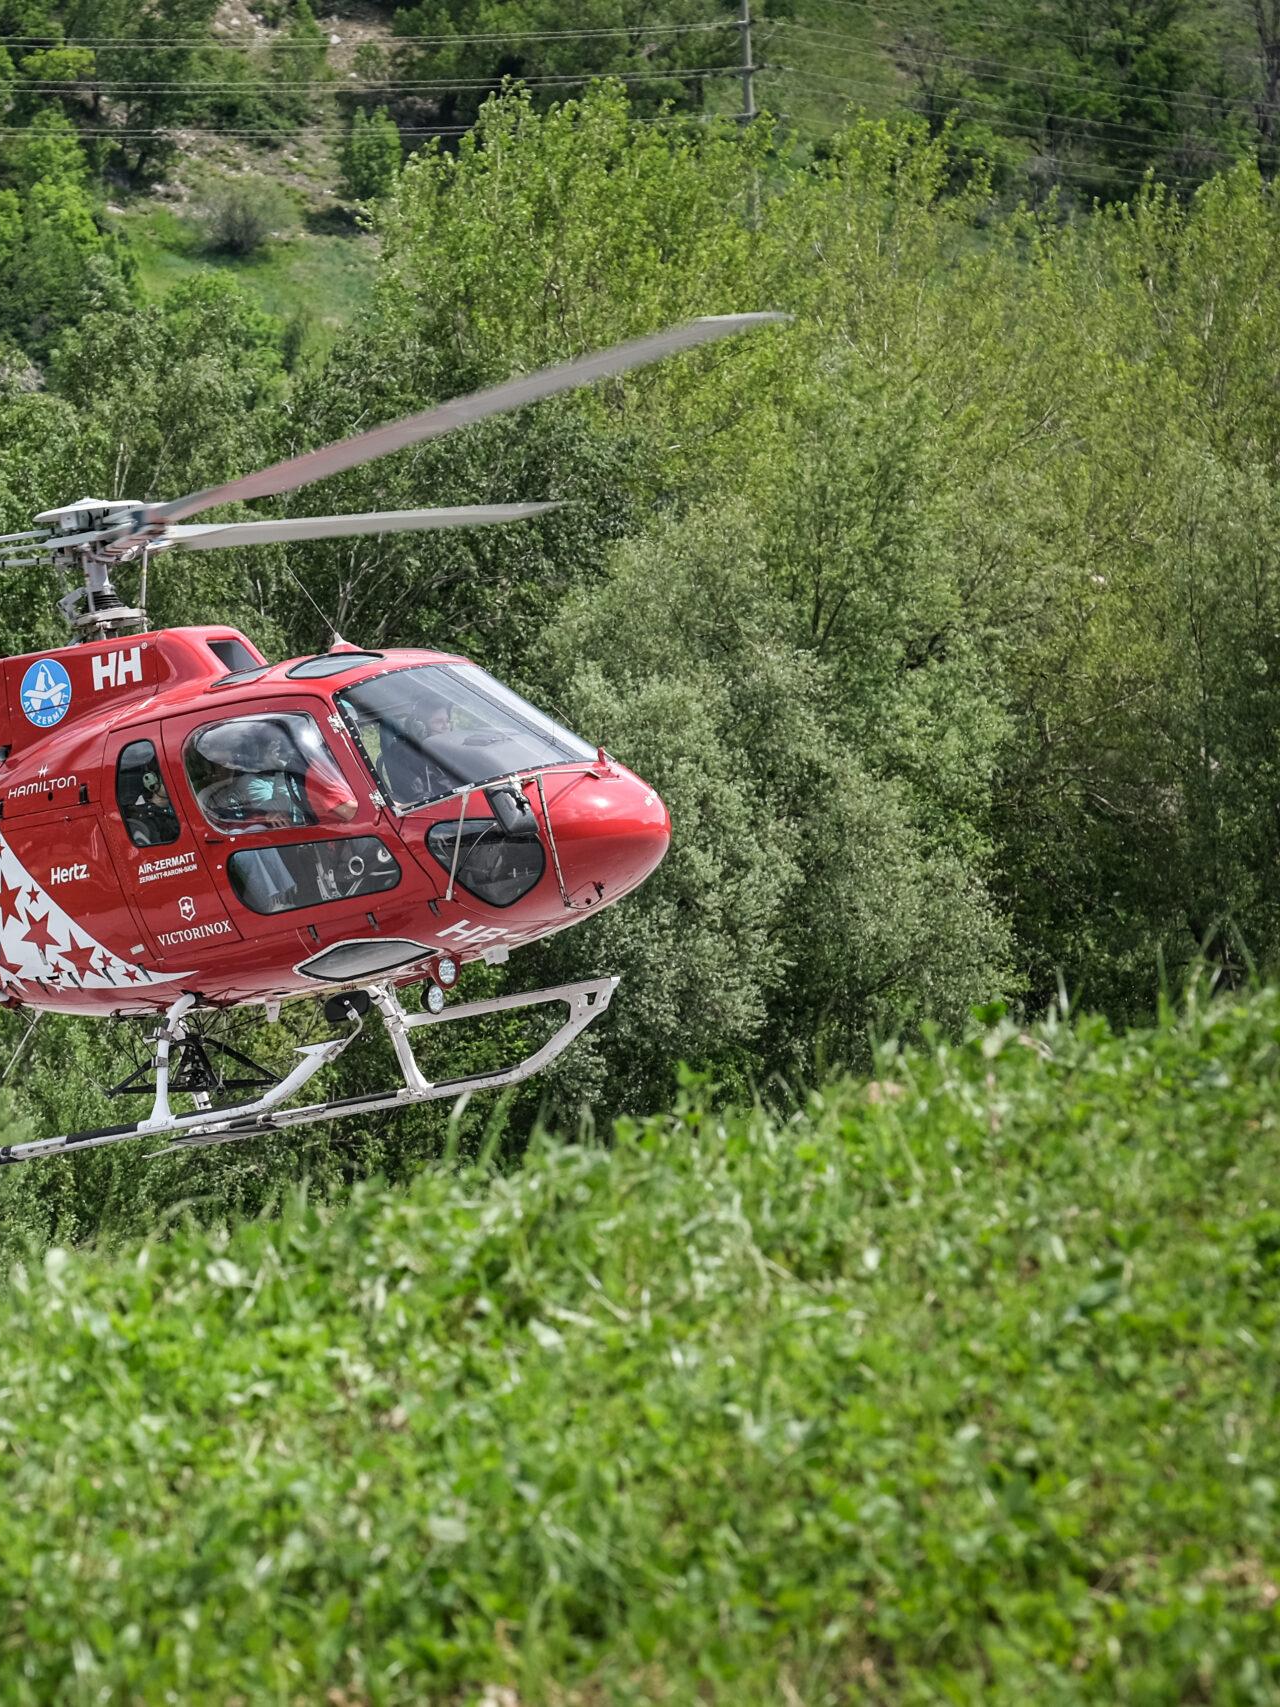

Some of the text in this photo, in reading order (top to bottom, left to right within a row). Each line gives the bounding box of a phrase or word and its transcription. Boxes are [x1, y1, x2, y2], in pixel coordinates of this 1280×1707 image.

[7, 775, 77, 799] HAMILTON
[50, 863, 88, 885] Hertz
[138, 851, 196, 876] AIR-ZERMATT
[157, 919, 232, 946] VICTORINOX
